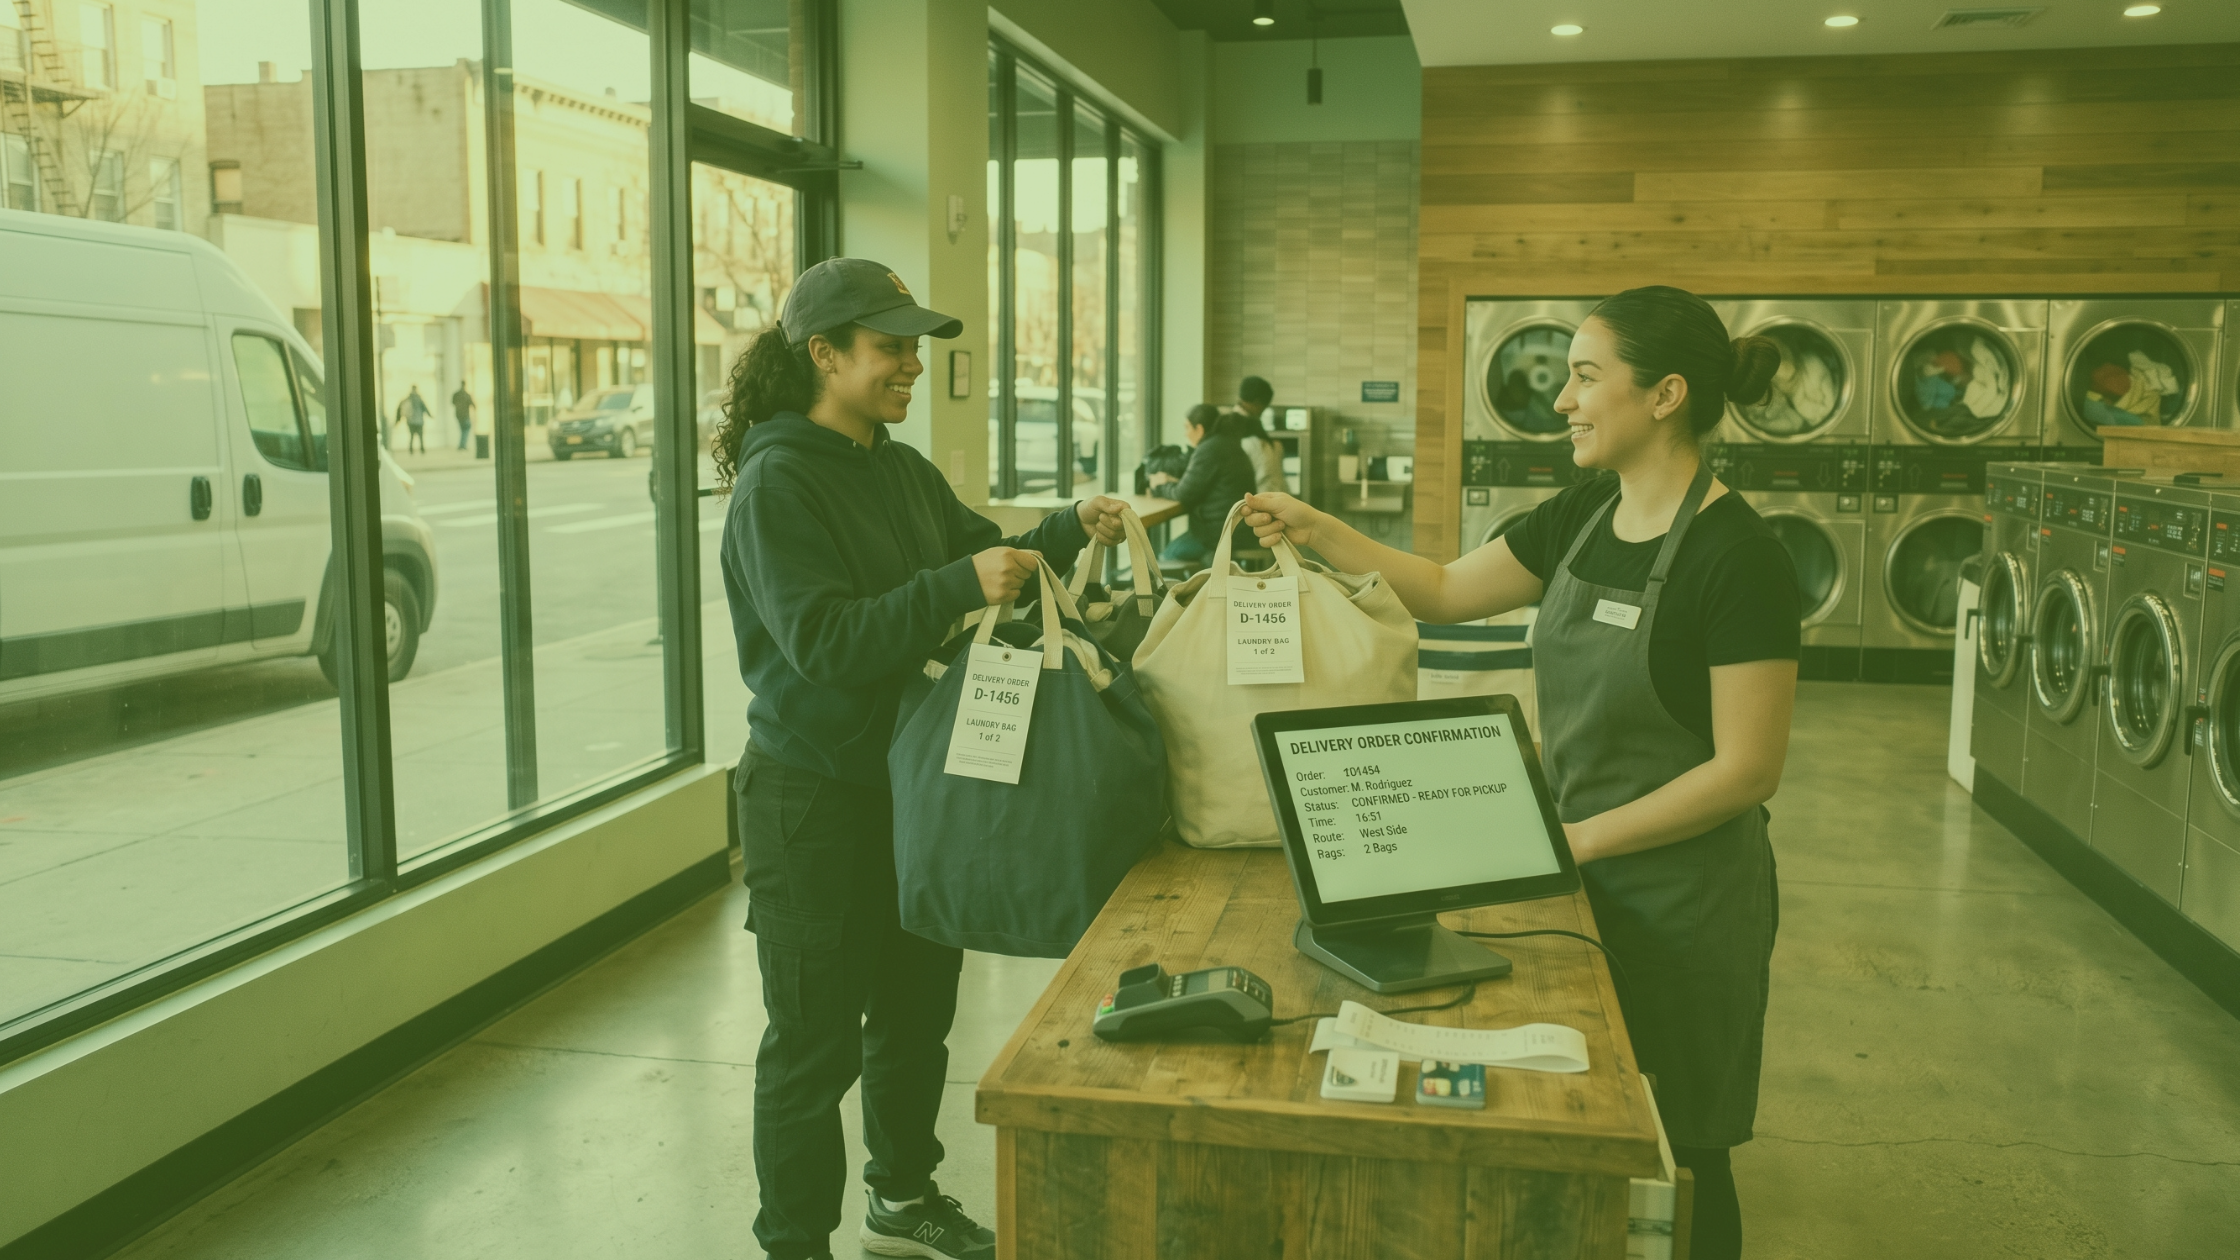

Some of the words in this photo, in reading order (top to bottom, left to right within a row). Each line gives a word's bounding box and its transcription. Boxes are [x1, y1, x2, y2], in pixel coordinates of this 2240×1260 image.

[1233, 600, 1266, 608] DELIVERY
[1240, 612, 1286, 624] D-1456
[1274, 637, 1290, 645] BAG
[972, 673, 1006, 684] DELIVERY
[1006, 677, 1030, 687] ORDER
[974, 687, 1020, 705] D-1456
[966, 718, 1000, 729] LAUNDRY
[1001, 722, 1017, 732] BAG
[978, 732, 983, 740] 1
[985, 733, 994, 741] of
[995, 734, 1001, 743] 2
[1290, 737, 1353, 755] DELIVERY
[1357, 733, 1402, 749] ORDER
[1403, 725, 1502, 745] CONFIRMATION
[1295, 770, 1326, 782] Order:
[1300, 784, 1350, 797] Customer:
[1350, 782, 1364, 792] M.
[1365, 779, 1413, 791] Rodriguez
[1304, 801, 1340, 812] Status:
[1351, 792, 1410, 808] CONFIRMED
[1417, 788, 1449, 801] READY
[1451, 786, 1472, 798] FOR
[1472, 782, 1508, 796] PICKUP
[1307, 816, 1337, 828] Time:
[1355, 810, 1382, 823] 16:51
[1312, 832, 1345, 844] Route:
[1385, 823, 1408, 836] Side
[1363, 843, 1371, 854] 2
[1372, 842, 1398, 853] Bags
[912, 1220, 945, 1245] N
